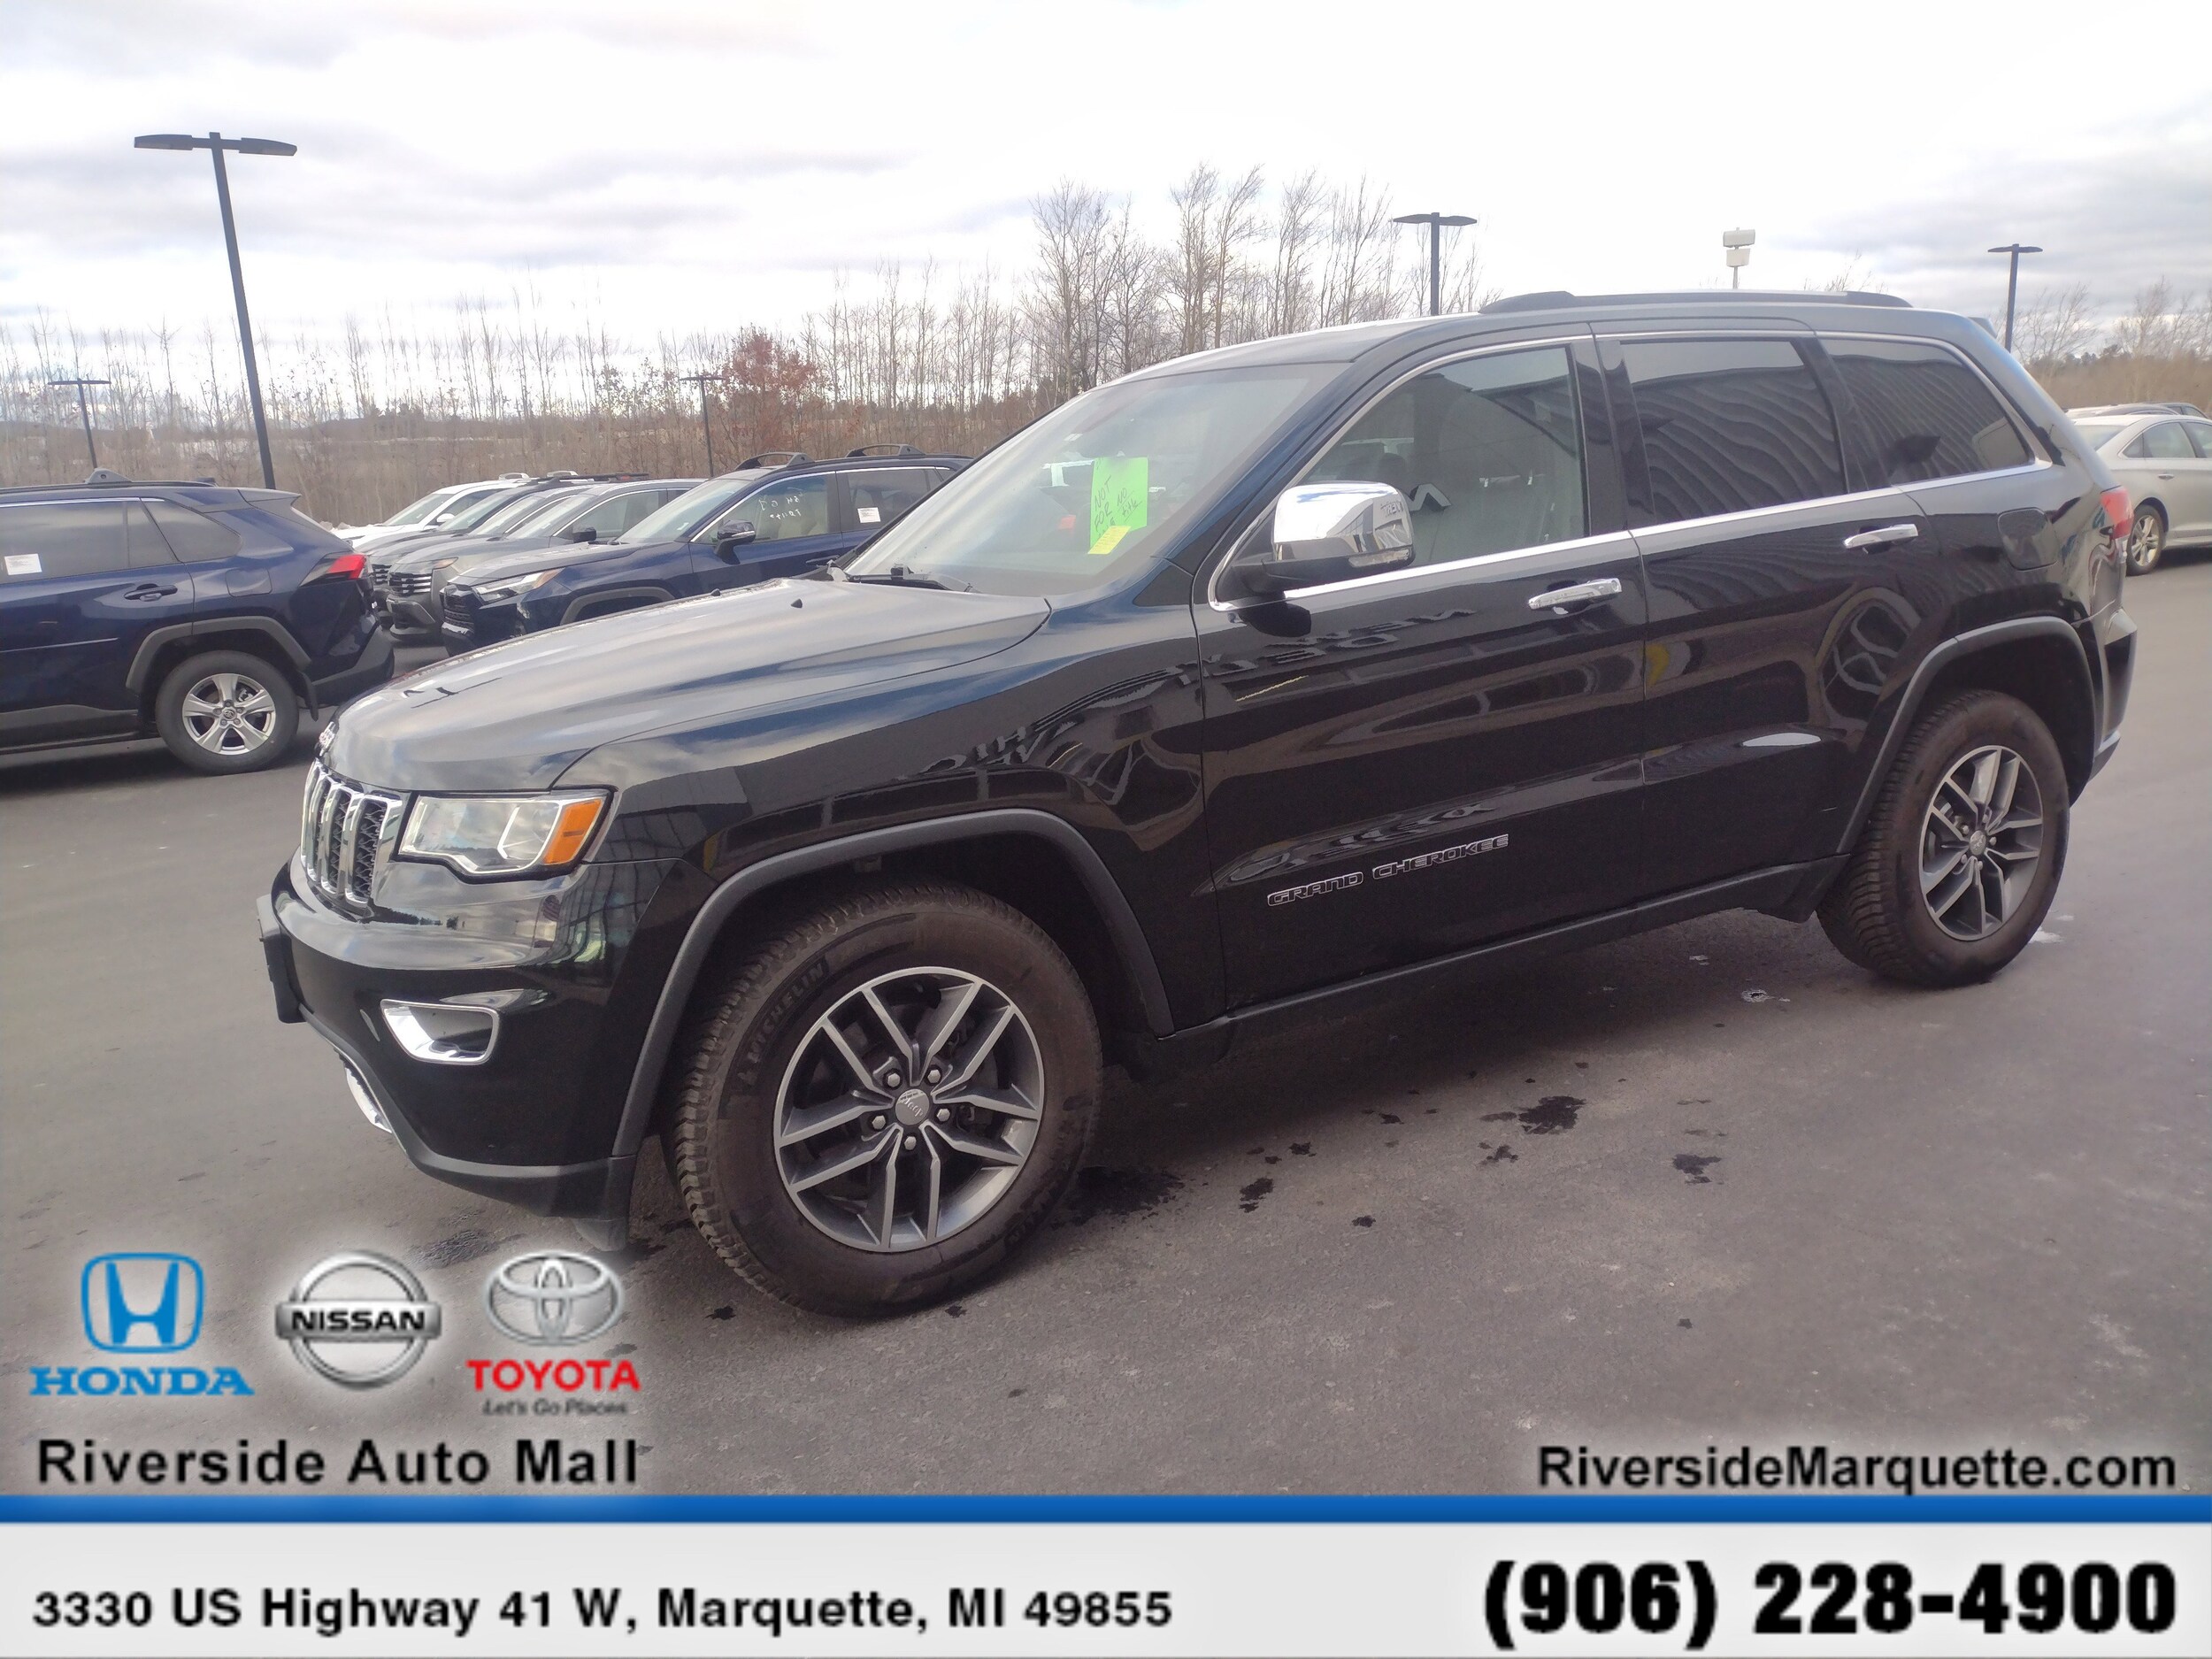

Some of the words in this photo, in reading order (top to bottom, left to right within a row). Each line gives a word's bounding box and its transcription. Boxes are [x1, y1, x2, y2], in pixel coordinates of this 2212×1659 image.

[1094, 475, 1112, 511] NOT
[1094, 502, 1113, 533] FOR
[1267, 871, 1363, 906] GRAND
[1372, 833, 1509, 879] CHEROKEE
[747, 963, 825, 1064] MICHELIN
